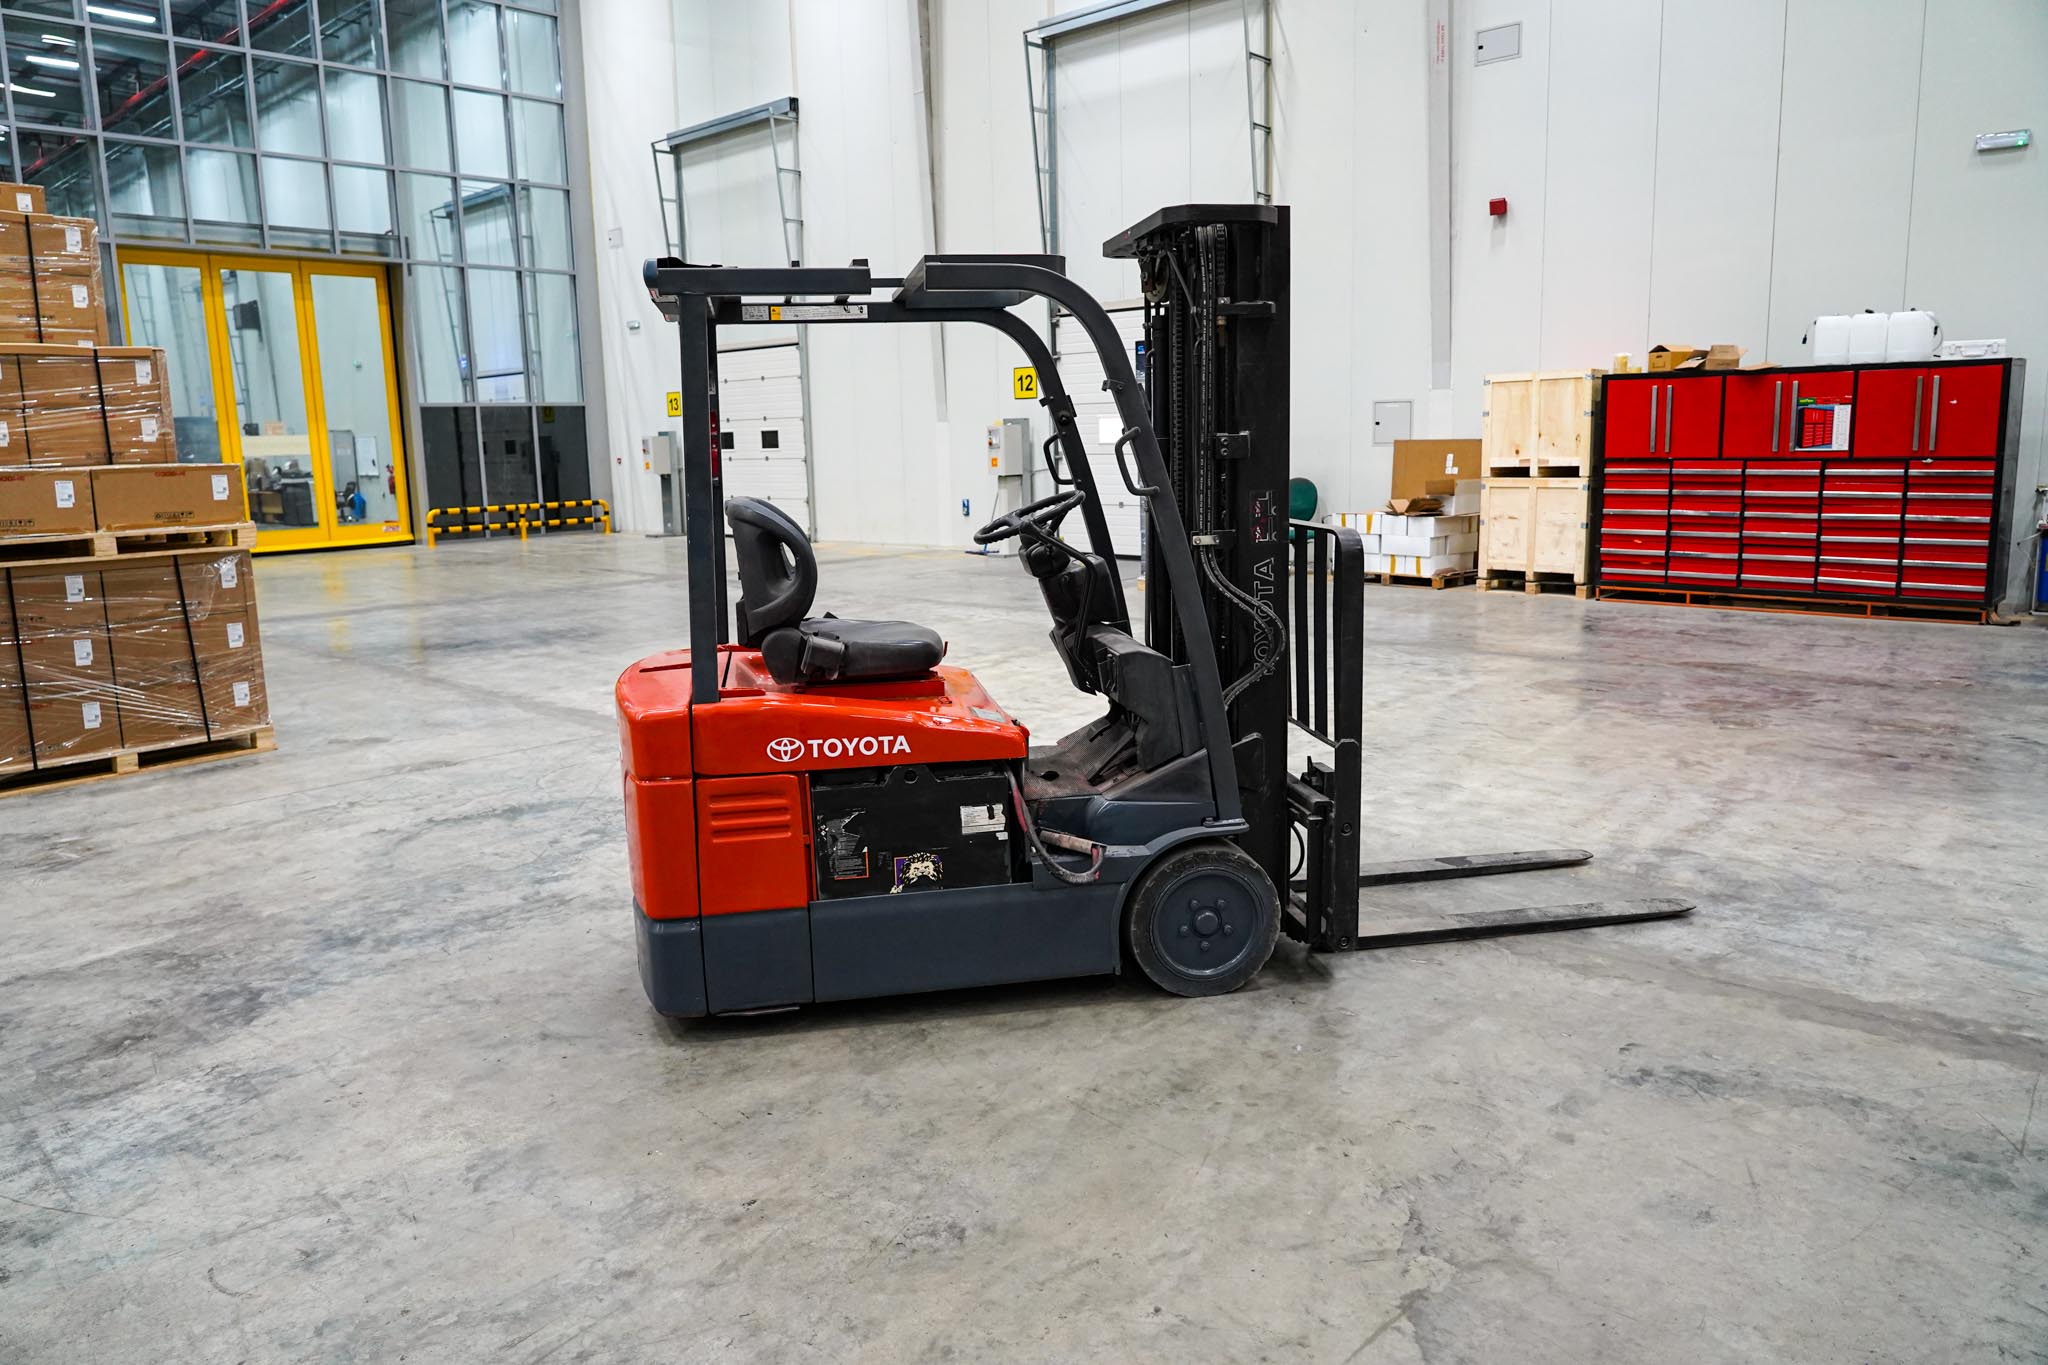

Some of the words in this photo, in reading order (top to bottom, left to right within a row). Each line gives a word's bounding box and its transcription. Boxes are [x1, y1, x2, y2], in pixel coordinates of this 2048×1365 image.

[1017, 374, 1034, 392] 12
[669, 397, 680, 412] 13
[807, 735, 912, 758] TOYOTA
